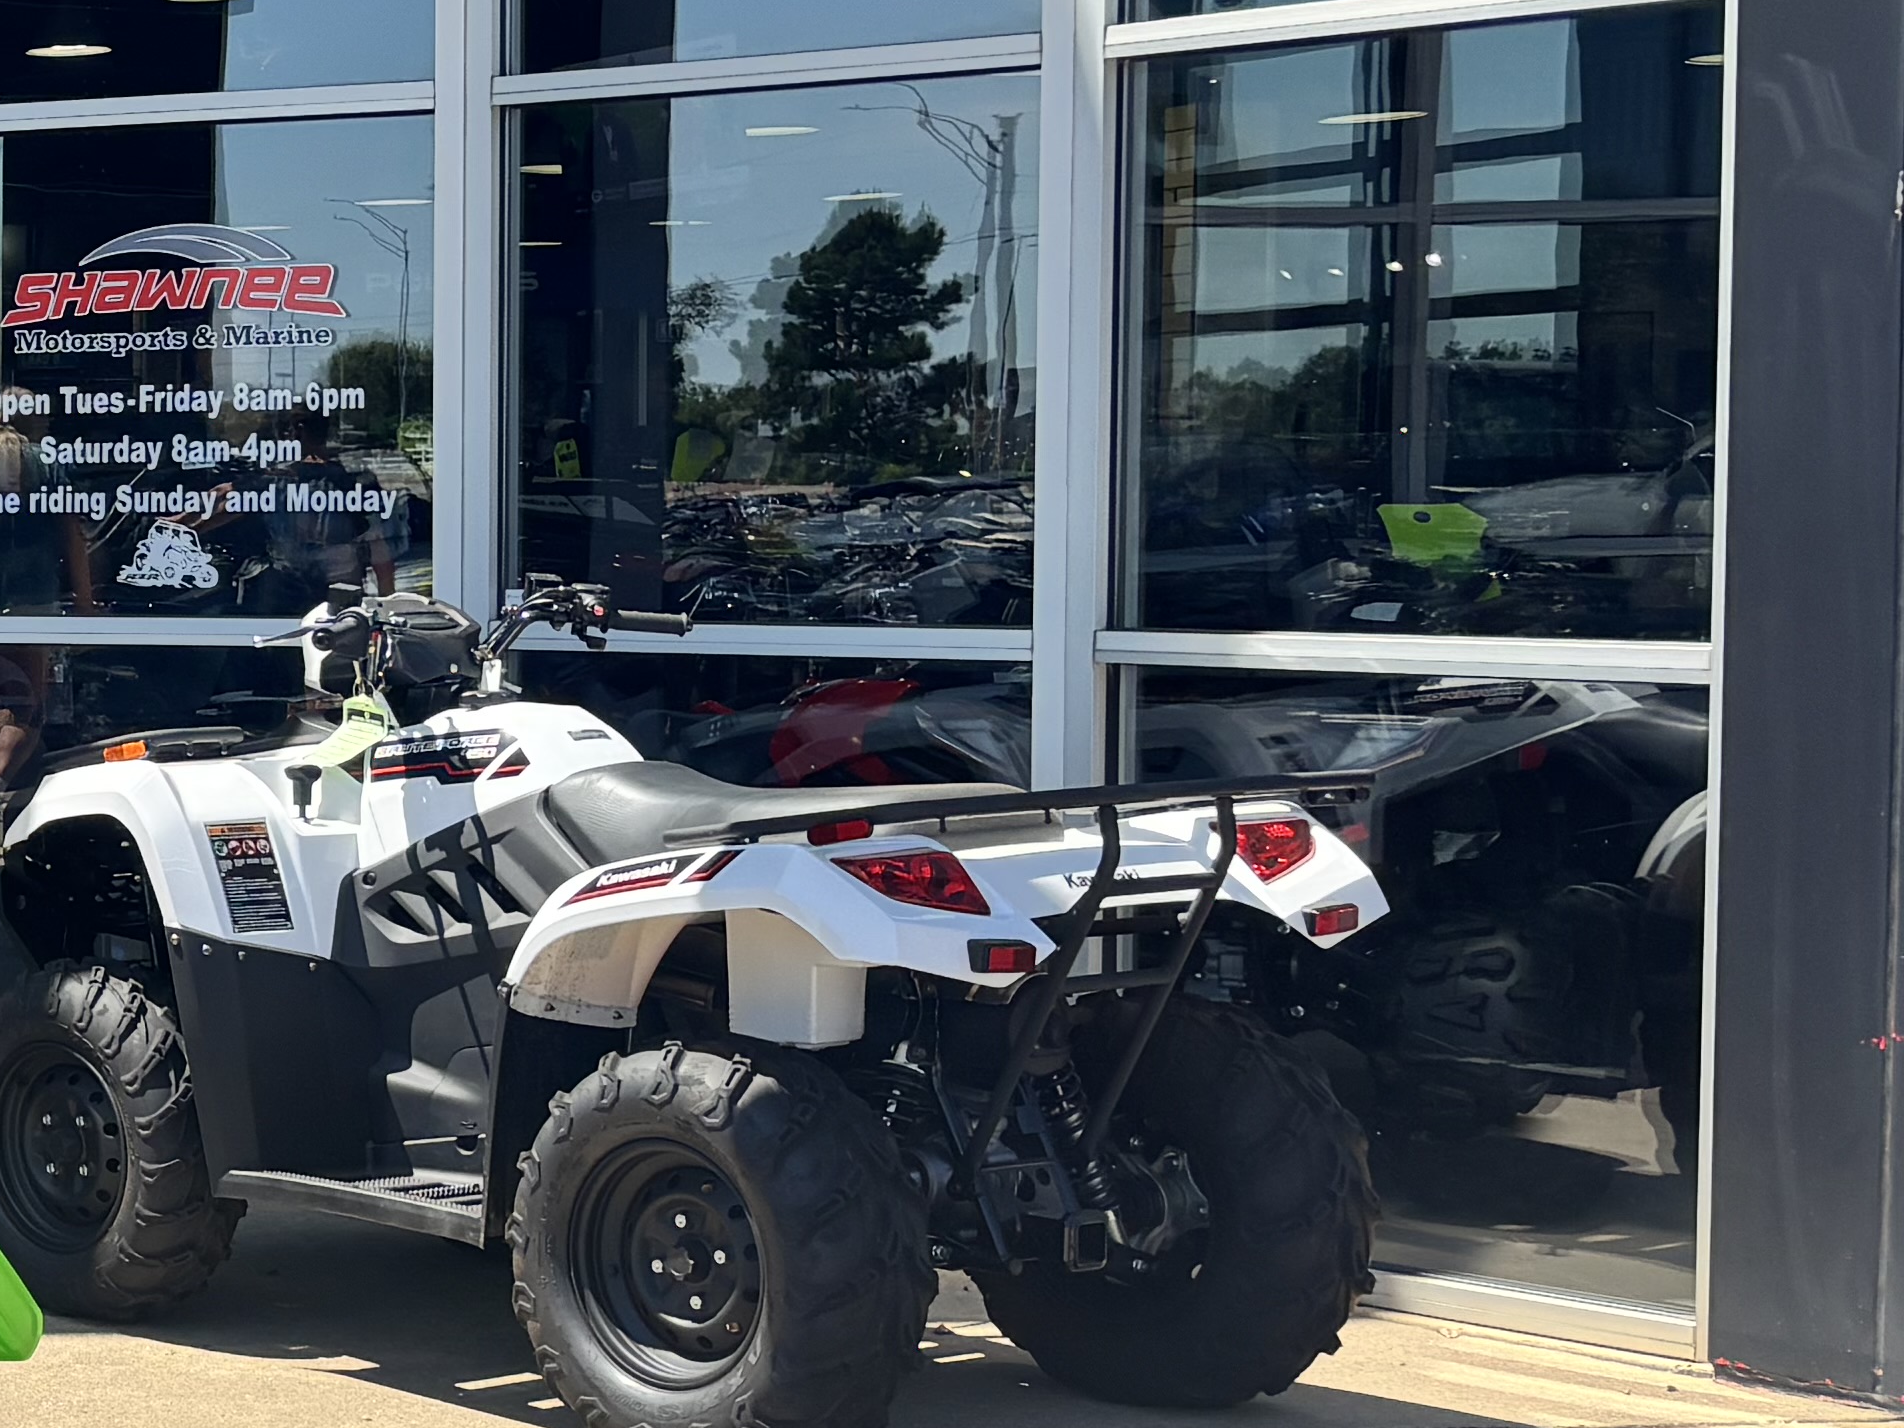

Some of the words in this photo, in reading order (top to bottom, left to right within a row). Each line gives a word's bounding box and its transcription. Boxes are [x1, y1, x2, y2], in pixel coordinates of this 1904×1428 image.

[14, 329, 187, 356] Motorsports
[194, 328, 216, 349] &
[224, 325, 333, 347] Marine
[60, 385, 223, 419] Tues-Friday
[233, 383, 365, 414] 8am-6pm
[40, 435, 163, 470] Saturday
[171, 434, 302, 468] 8am-4pm
[29, 484, 106, 517] riding
[115, 483, 217, 518] Sunday
[225, 484, 277, 513] and
[287, 482, 396, 519] Monday
[596, 859, 678, 887] Kawasaki
